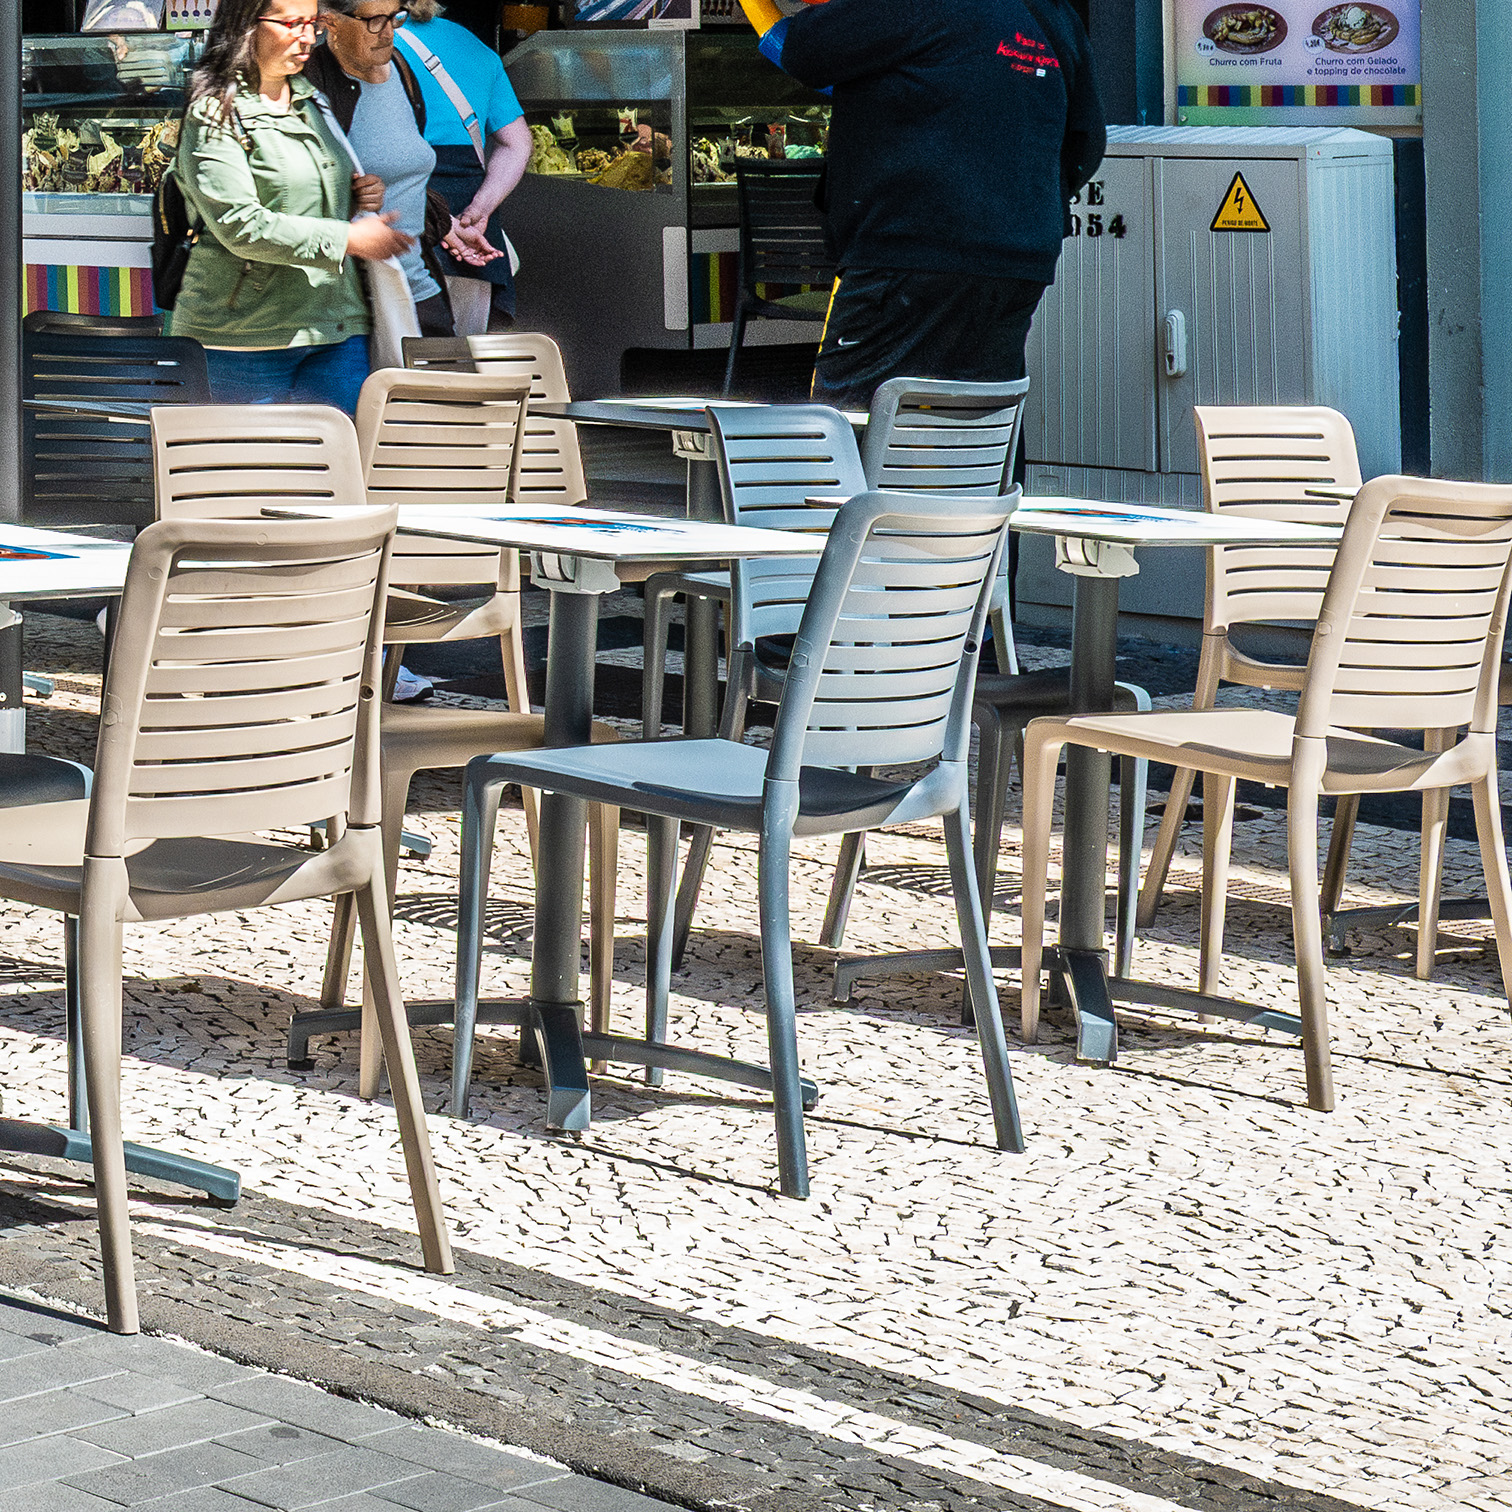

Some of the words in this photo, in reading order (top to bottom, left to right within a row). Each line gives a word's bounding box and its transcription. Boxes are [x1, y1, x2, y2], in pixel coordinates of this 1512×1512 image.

[1209, 58, 1237, 66] Churro
[1239, 58, 1257, 66] com
[1260, 57, 1282, 65] Fruta
[1315, 57, 1344, 65] Churro
[1367, 56, 1398, 65] Gelado
[1314, 67, 1348, 76] topping
[1350, 67, 1362, 75] de
[1364, 66, 1406, 75] chocolate
